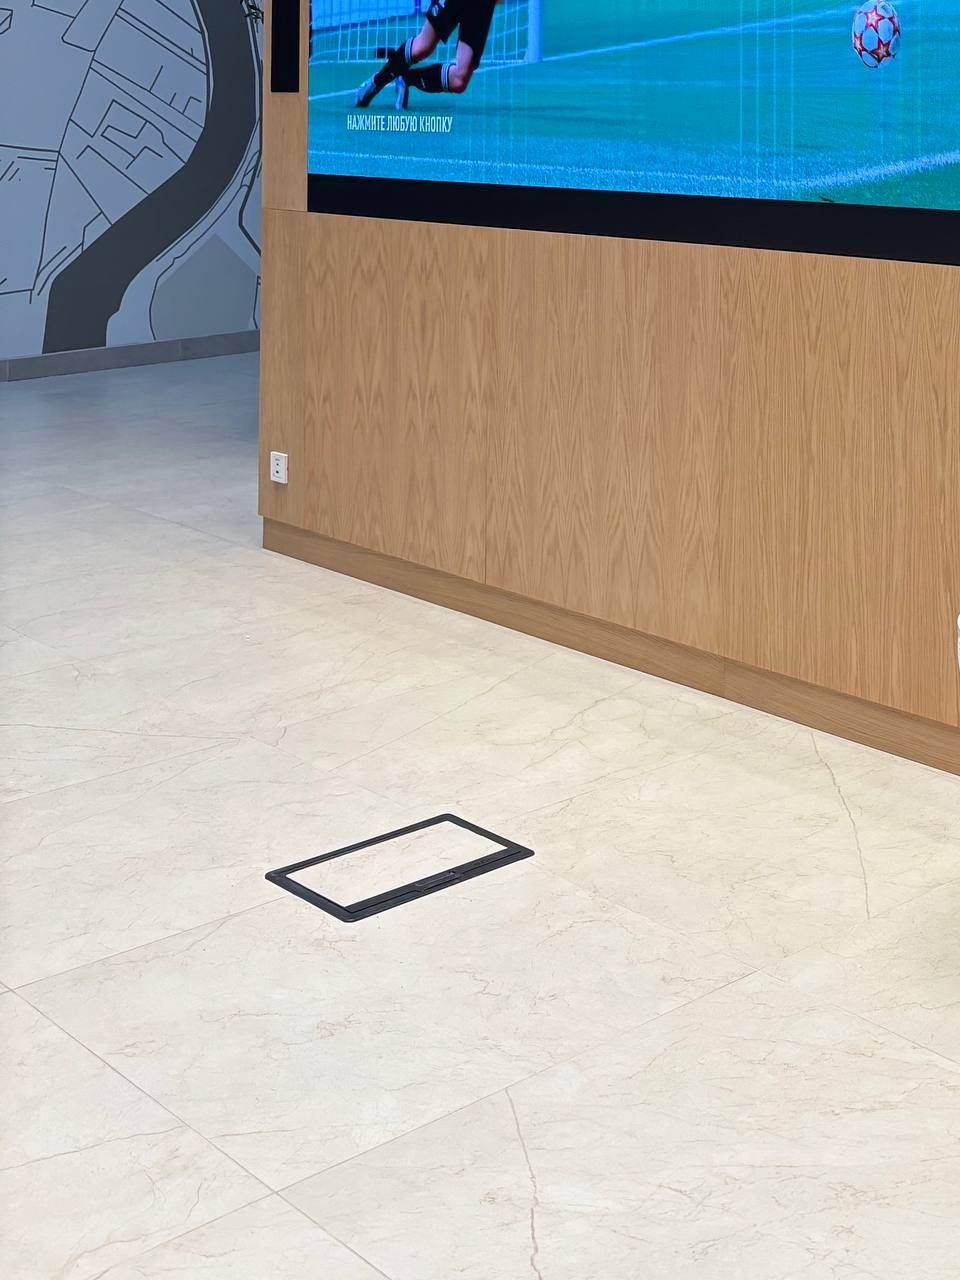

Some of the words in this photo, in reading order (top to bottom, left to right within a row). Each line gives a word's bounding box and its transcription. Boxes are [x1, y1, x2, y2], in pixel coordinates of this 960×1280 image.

[346, 113, 386, 132] НАЖМИТЕ
[386, 115, 418, 132] ЛЮБУЮ
[419, 116, 453, 133] КНОПКУ
